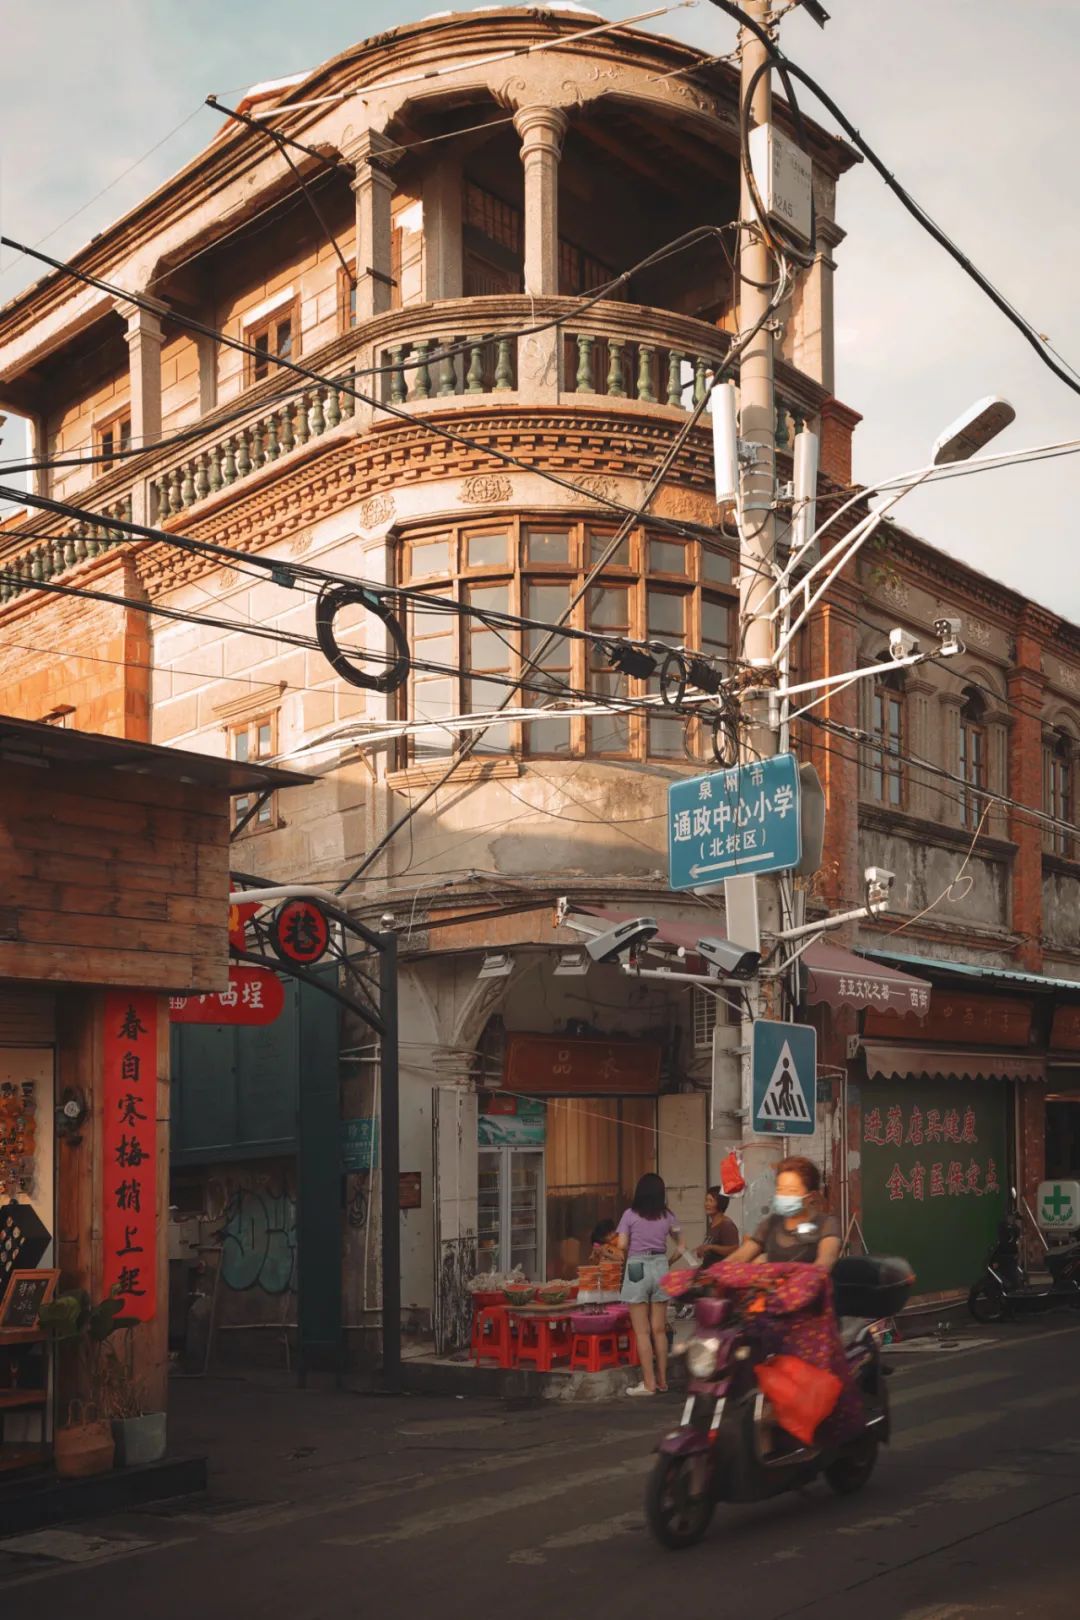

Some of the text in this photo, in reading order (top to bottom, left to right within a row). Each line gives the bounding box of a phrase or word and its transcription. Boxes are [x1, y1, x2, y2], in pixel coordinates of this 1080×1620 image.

[698, 767, 765, 801] 泉州市
[673, 784, 794, 842] 通政中心小学
